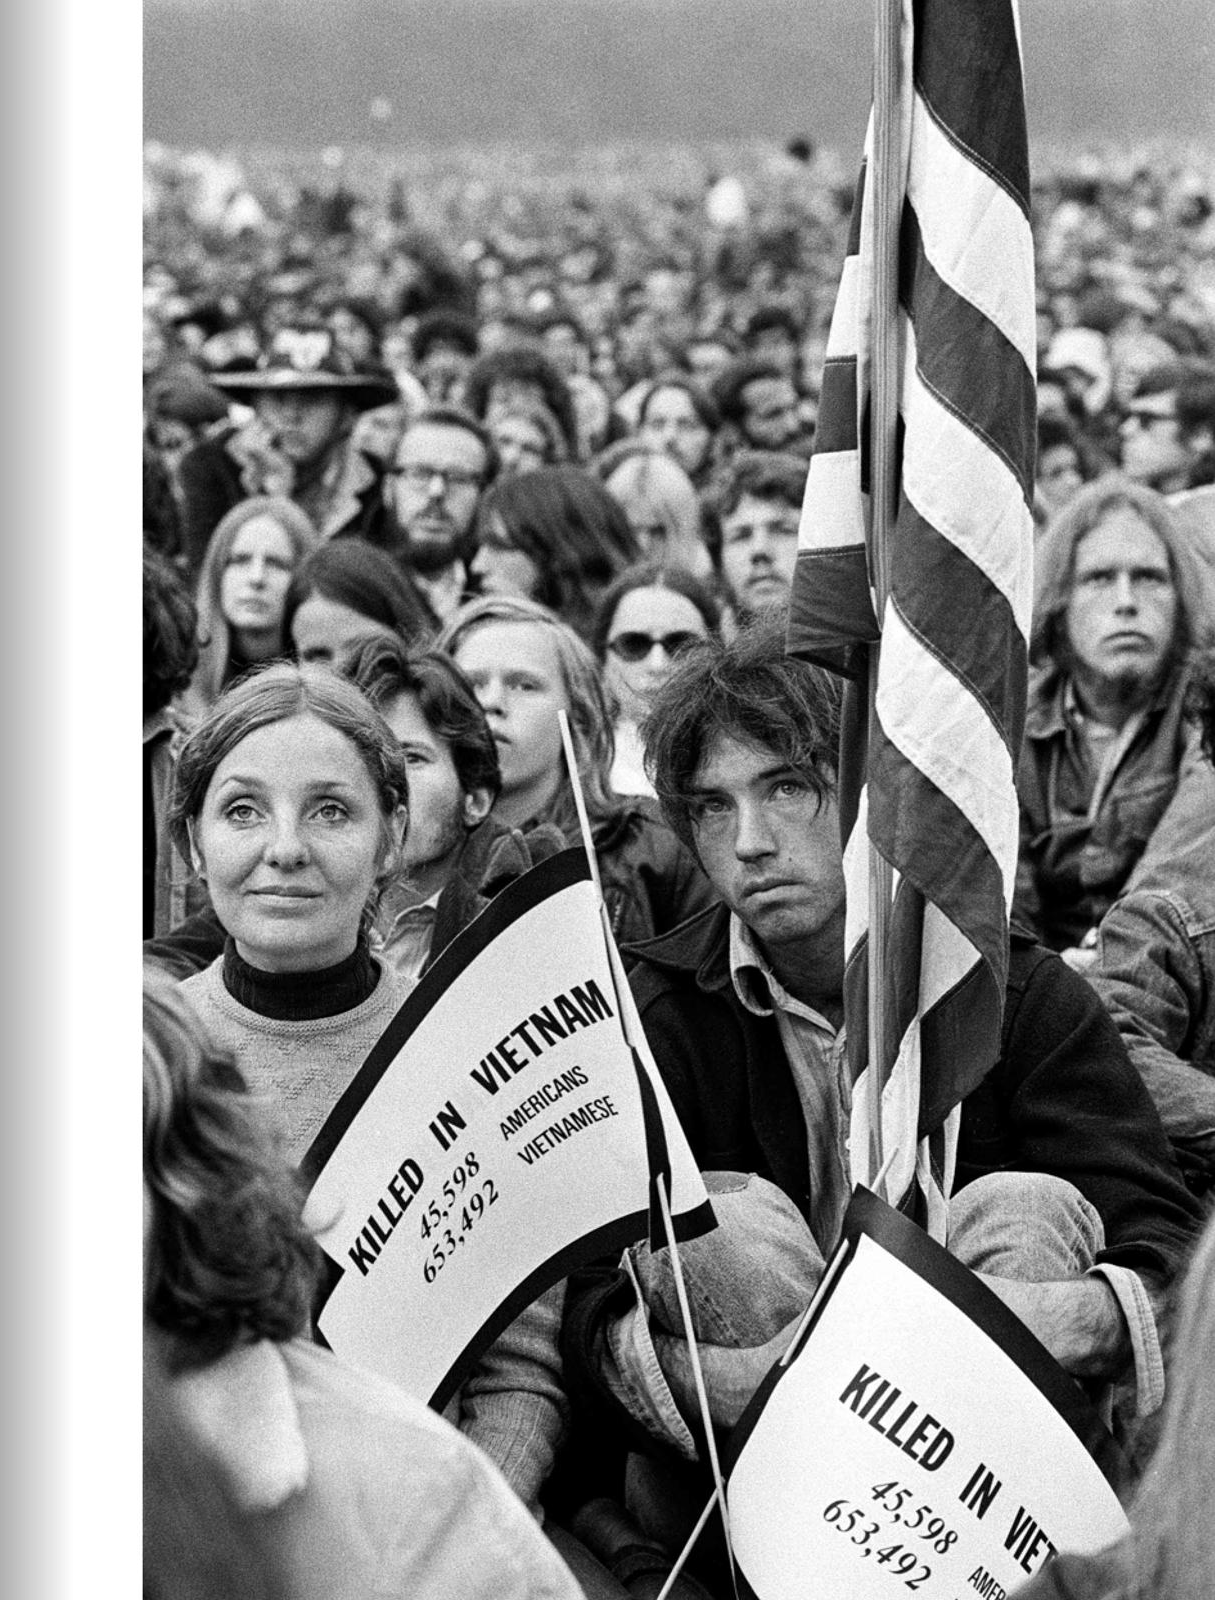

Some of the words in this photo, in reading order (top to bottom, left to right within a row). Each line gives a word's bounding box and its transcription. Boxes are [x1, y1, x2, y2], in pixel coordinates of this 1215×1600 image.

[348, 1159, 425, 1277] KILLED
[429, 1101, 467, 1152] IN
[469, 979, 615, 1096] VIETNAM
[419, 1151, 481, 1240] 45,598
[499, 1065, 590, 1141] AMERICANS
[423, 1179, 500, 1284] 653,492
[517, 1095, 619, 1166] VIETNAMESE
[839, 1363, 955, 1472] KILLED
[958, 1462, 1003, 1520] IN
[870, 1481, 959, 1555] 45,598
[822, 1499, 932, 1591] 653,492
